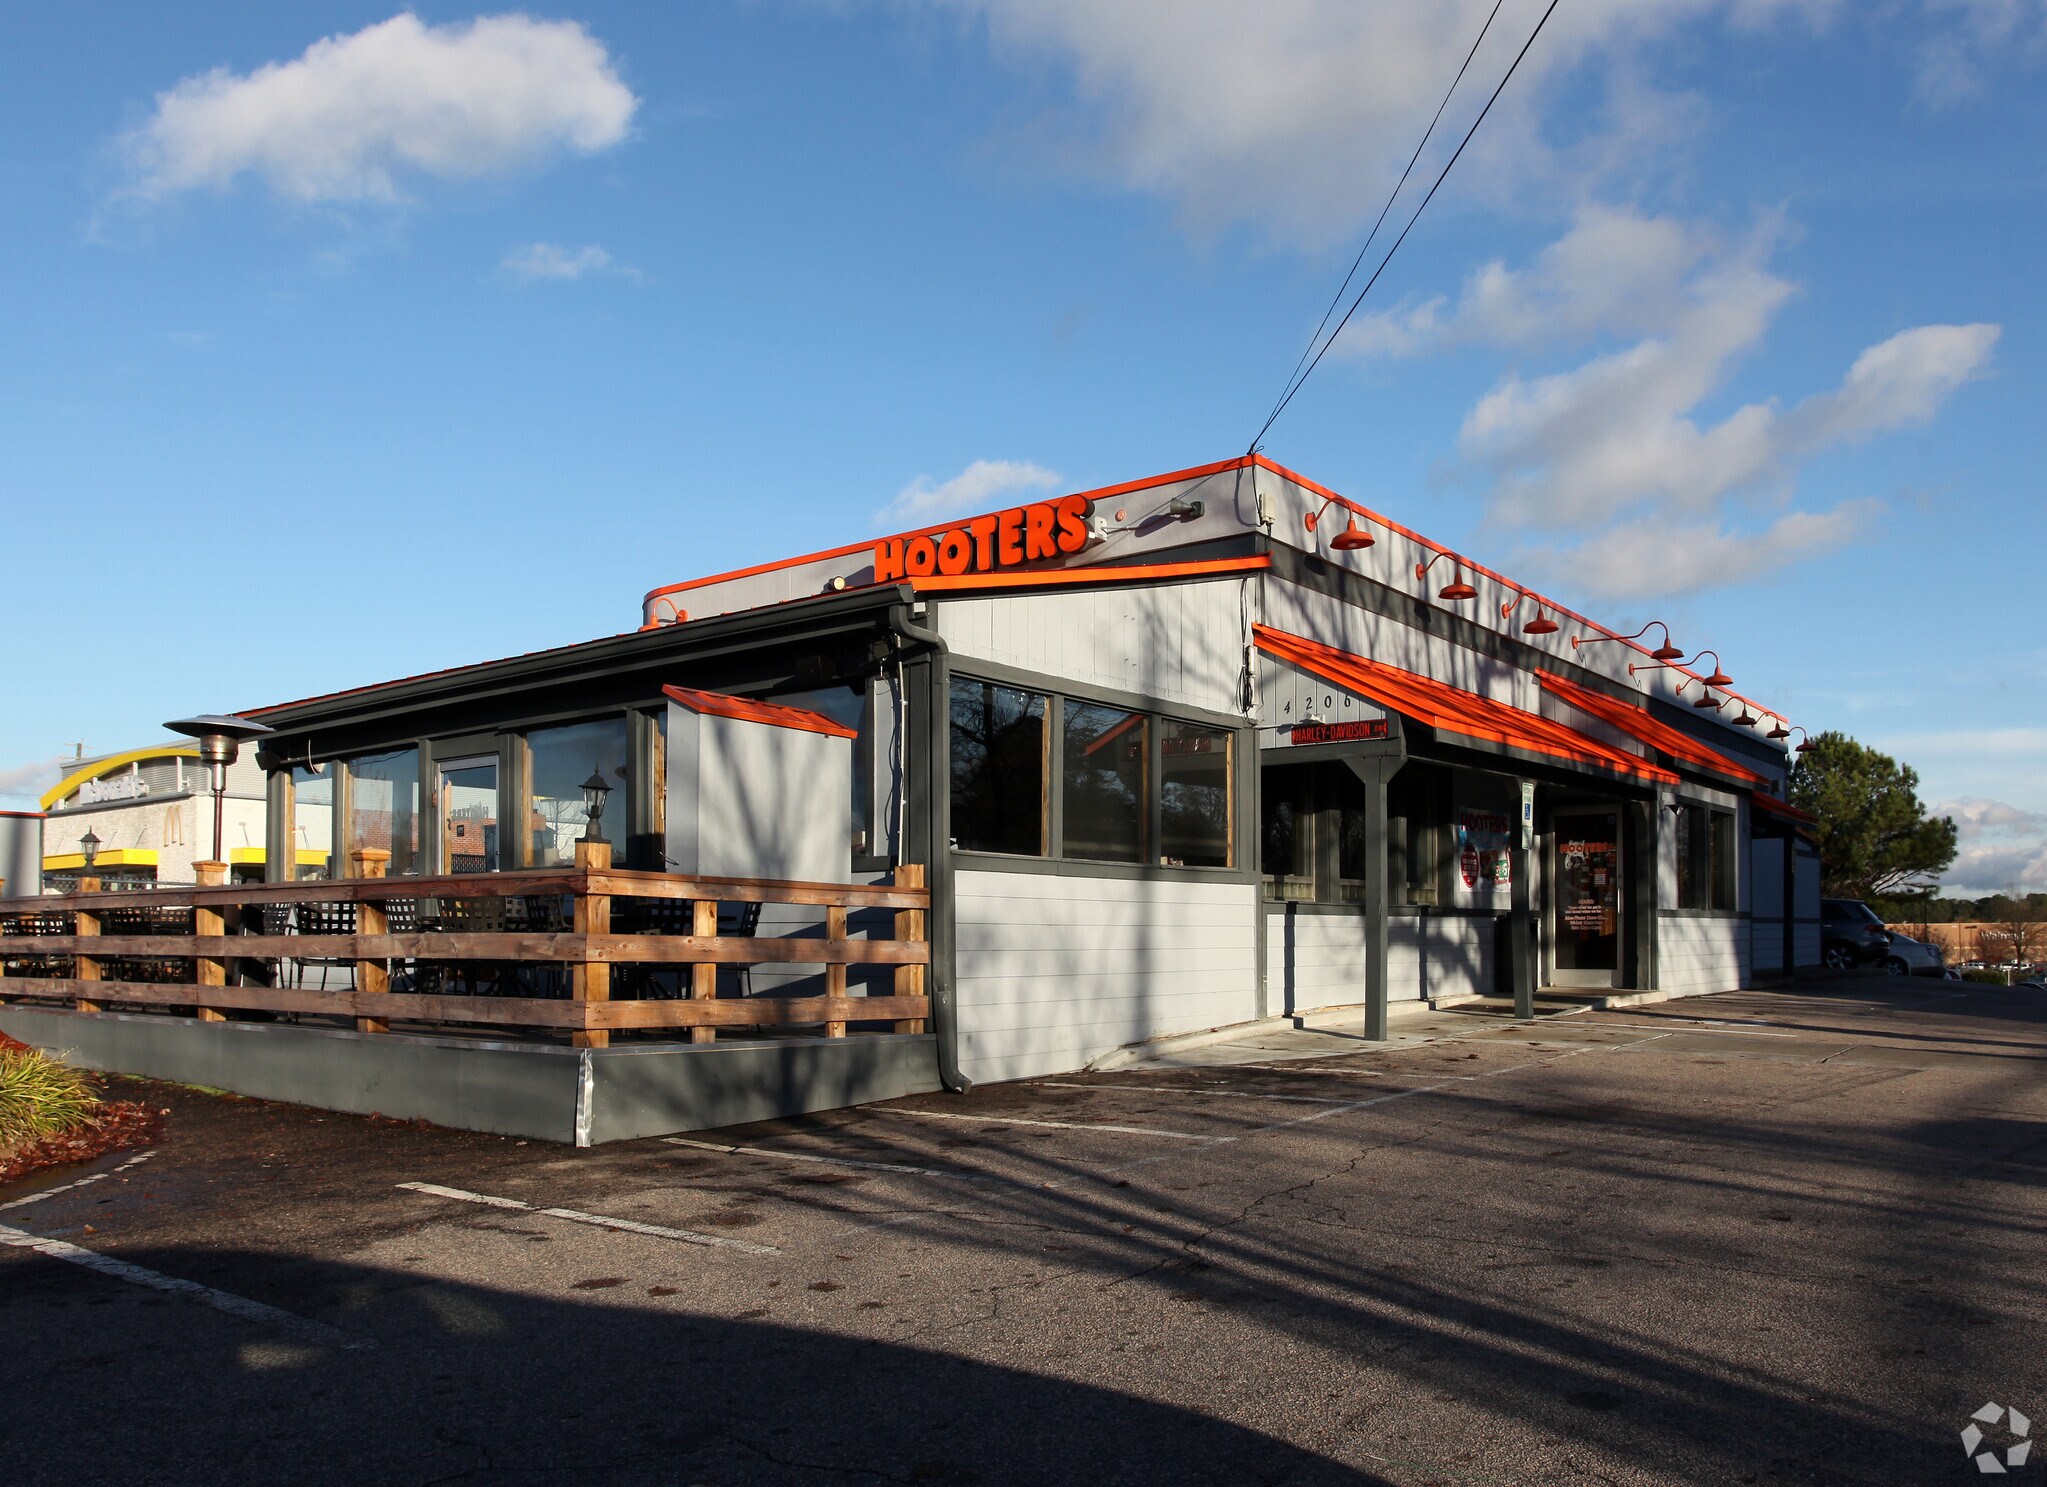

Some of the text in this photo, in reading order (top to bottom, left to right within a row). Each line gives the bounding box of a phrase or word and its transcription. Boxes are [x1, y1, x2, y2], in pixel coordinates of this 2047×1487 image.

[874, 494, 1090, 583] HOOTERS
[1284, 694, 1351, 714] 4206
[1296, 723, 1371, 742] HARLEY-DAVIDSON
